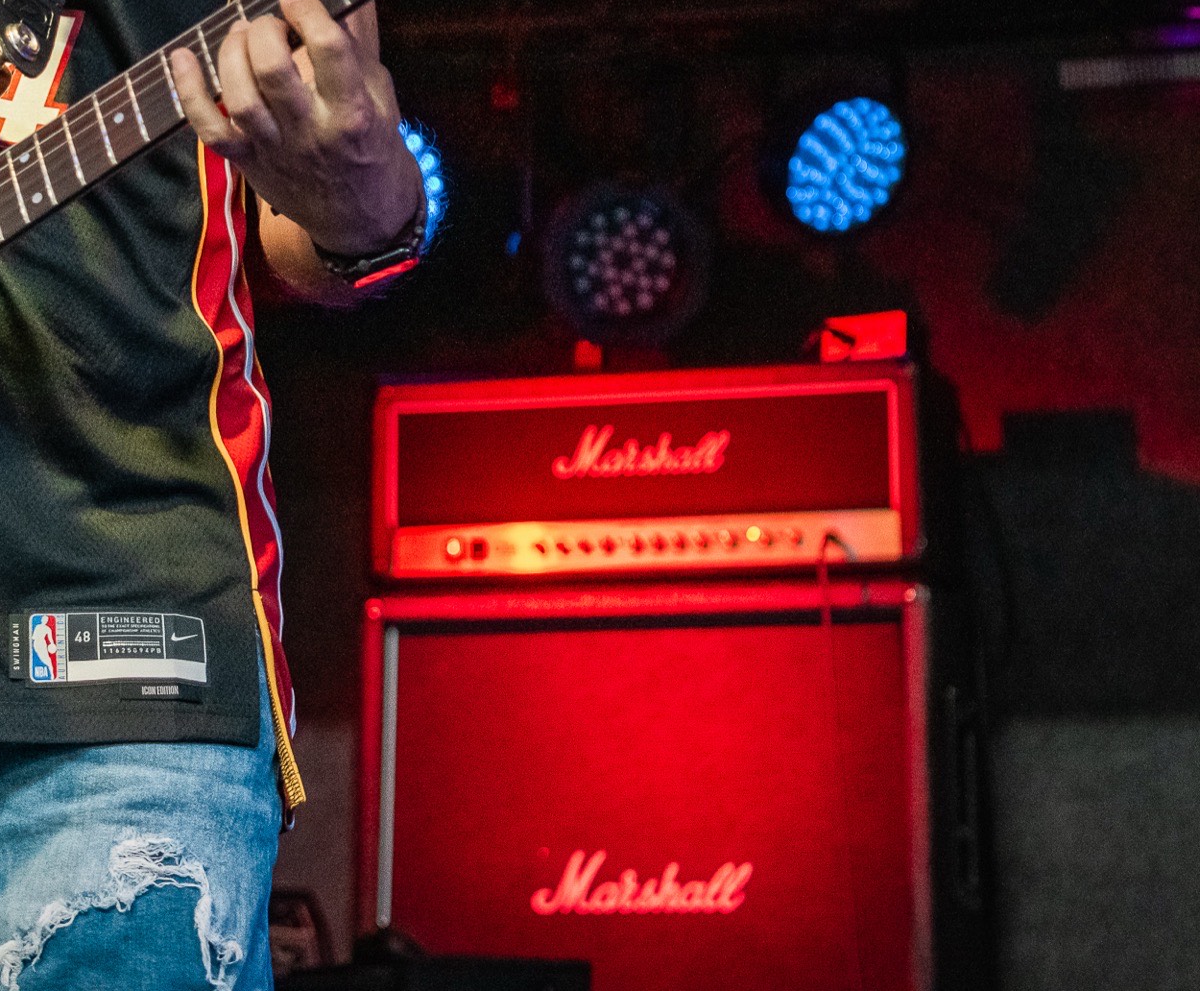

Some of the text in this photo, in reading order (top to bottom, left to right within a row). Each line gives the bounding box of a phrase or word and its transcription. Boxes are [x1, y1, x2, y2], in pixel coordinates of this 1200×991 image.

[552, 424, 731, 479] Marshall
[100, 616, 161, 624] ENGINEERED
[74, 630, 91, 643] 48
[34, 666, 49, 678] NBA
[141, 685, 179, 695] ICON EDITION
[531, 850, 754, 916] Marshall
